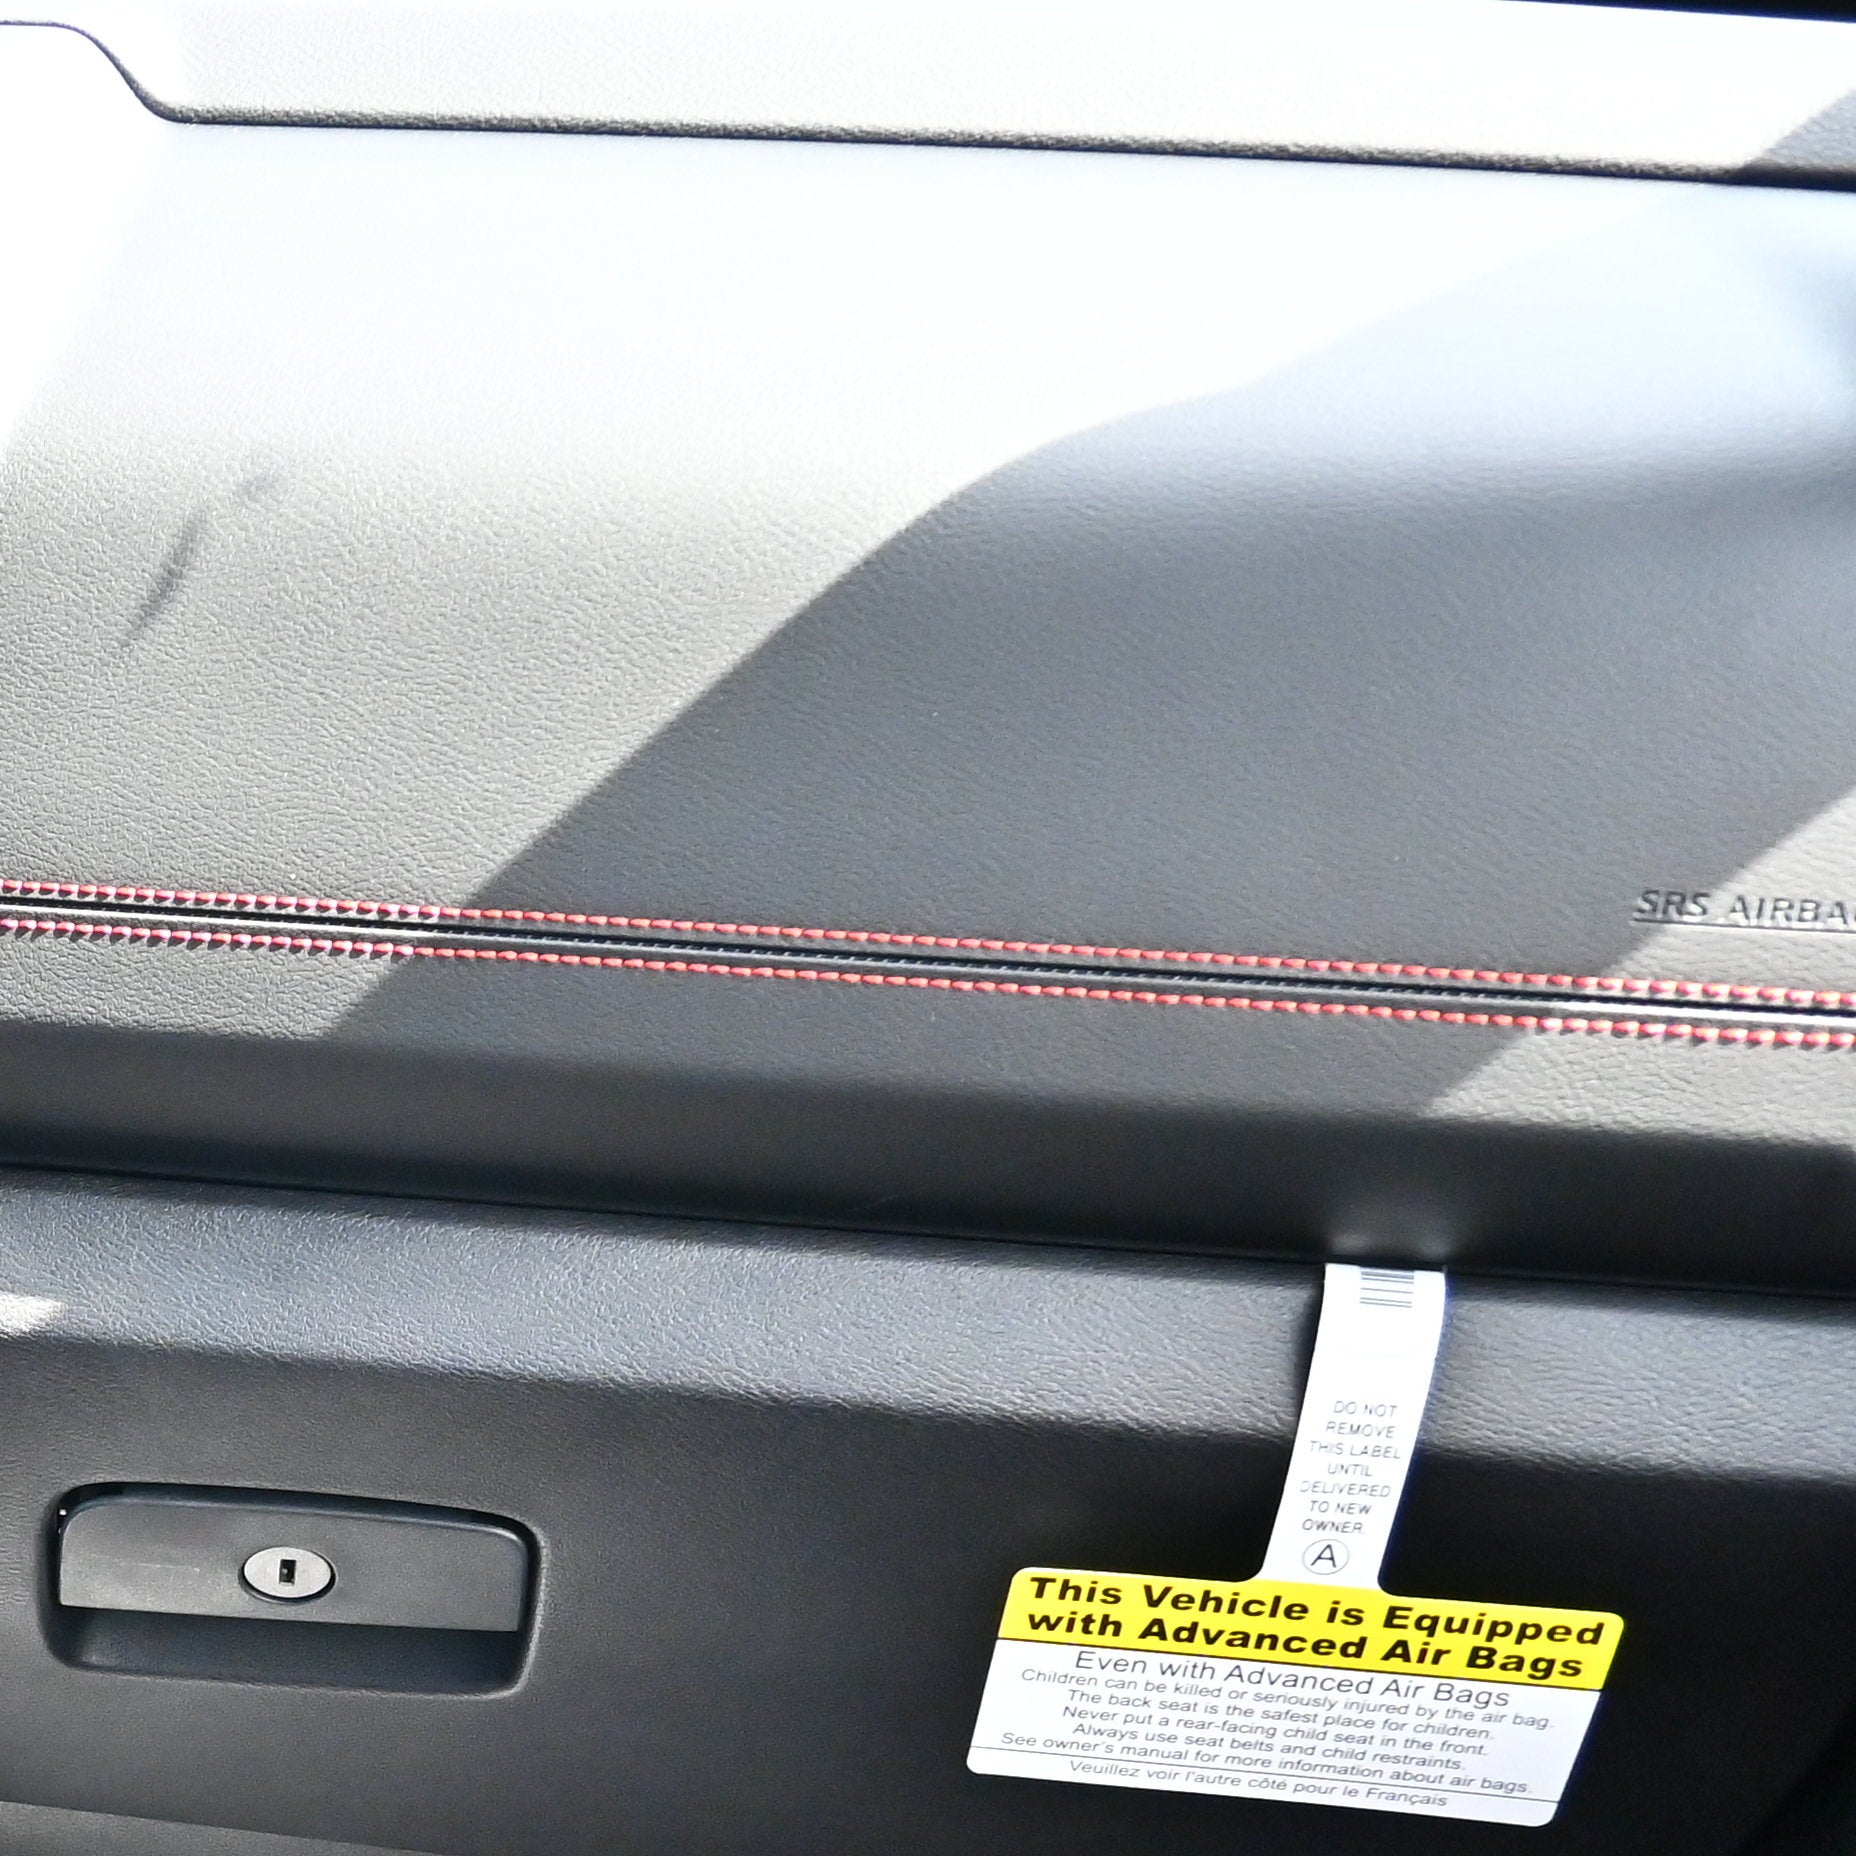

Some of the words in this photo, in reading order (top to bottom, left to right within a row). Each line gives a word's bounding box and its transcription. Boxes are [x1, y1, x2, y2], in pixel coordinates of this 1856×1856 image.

[1637, 890, 1711, 916] SRS
[1334, 1401, 1356, 1414] DO
[1364, 1404, 1397, 1417] NOT
[1326, 1421, 1395, 1438] REMOVE
[1310, 1441, 1344, 1455] THIS
[1350, 1444, 1400, 1459] LABEL
[1328, 1464, 1372, 1476] UNTIL
[1300, 1481, 1391, 1497] DELIVERED
[1310, 1500, 1329, 1513] TO
[1336, 1503, 1372, 1515] NEW
[1310, 1544, 1336, 1567] A
[1030, 1577, 1122, 1605] This
[1143, 1584, 1309, 1620] Vehicle
[1326, 1601, 1365, 1625] is
[1383, 1605, 1605, 1645] Equipped
[1028, 1612, 1122, 1637] with
[1138, 1618, 1367, 1659] Advanced
[1381, 1640, 1451, 1665] Air
[1466, 1646, 1583, 1680] Bags
[1075, 1651, 1147, 1674] Even
[1159, 1660, 1216, 1680] with
[1224, 1665, 1374, 1694] Advanced
[1380, 1679, 1425, 1699] Air
[1434, 1683, 1510, 1709] Bags
[1022, 1668, 1098, 1686] Children
[1105, 1677, 1137, 1690] can
[1145, 1680, 1167, 1693] be
[1174, 1684, 1222, 1698] killed
[1228, 1689, 1247, 1699] or
[1253, 1692, 1338, 1711] seriously
[1344, 1699, 1409, 1715] injured
[1415, 1705, 1438, 1720] by
[1445, 1709, 1475, 1721] the
[1481, 1713, 1507, 1724] air
[1512, 1715, 1554, 1730] bag.
[1068, 1690, 1102, 1704] The
[1108, 1693, 1151, 1709] back
[1158, 1700, 1198, 1712] seat
[1204, 1704, 1218, 1714] is
[1226, 1705, 1261, 1718] the
[1261, 1708, 1320, 1724] safest
[1323, 1713, 1375, 1729] place
[1382, 1719, 1408, 1731] for
[1413, 1722, 1494, 1740] children.
[1001, 1732, 1037, 1746] See
[1043, 1738, 1114, 1754] owner's
[1120, 1744, 1188, 1761] manual
[1194, 1750, 1220, 1763] for
[1225, 1756, 1271, 1768] more
[1278, 1759, 1383, 1779] information
[1390, 1770, 1444, 1785] about
[1450, 1775, 1476, 1787] air
[1480, 1777, 1531, 1793] bags.
